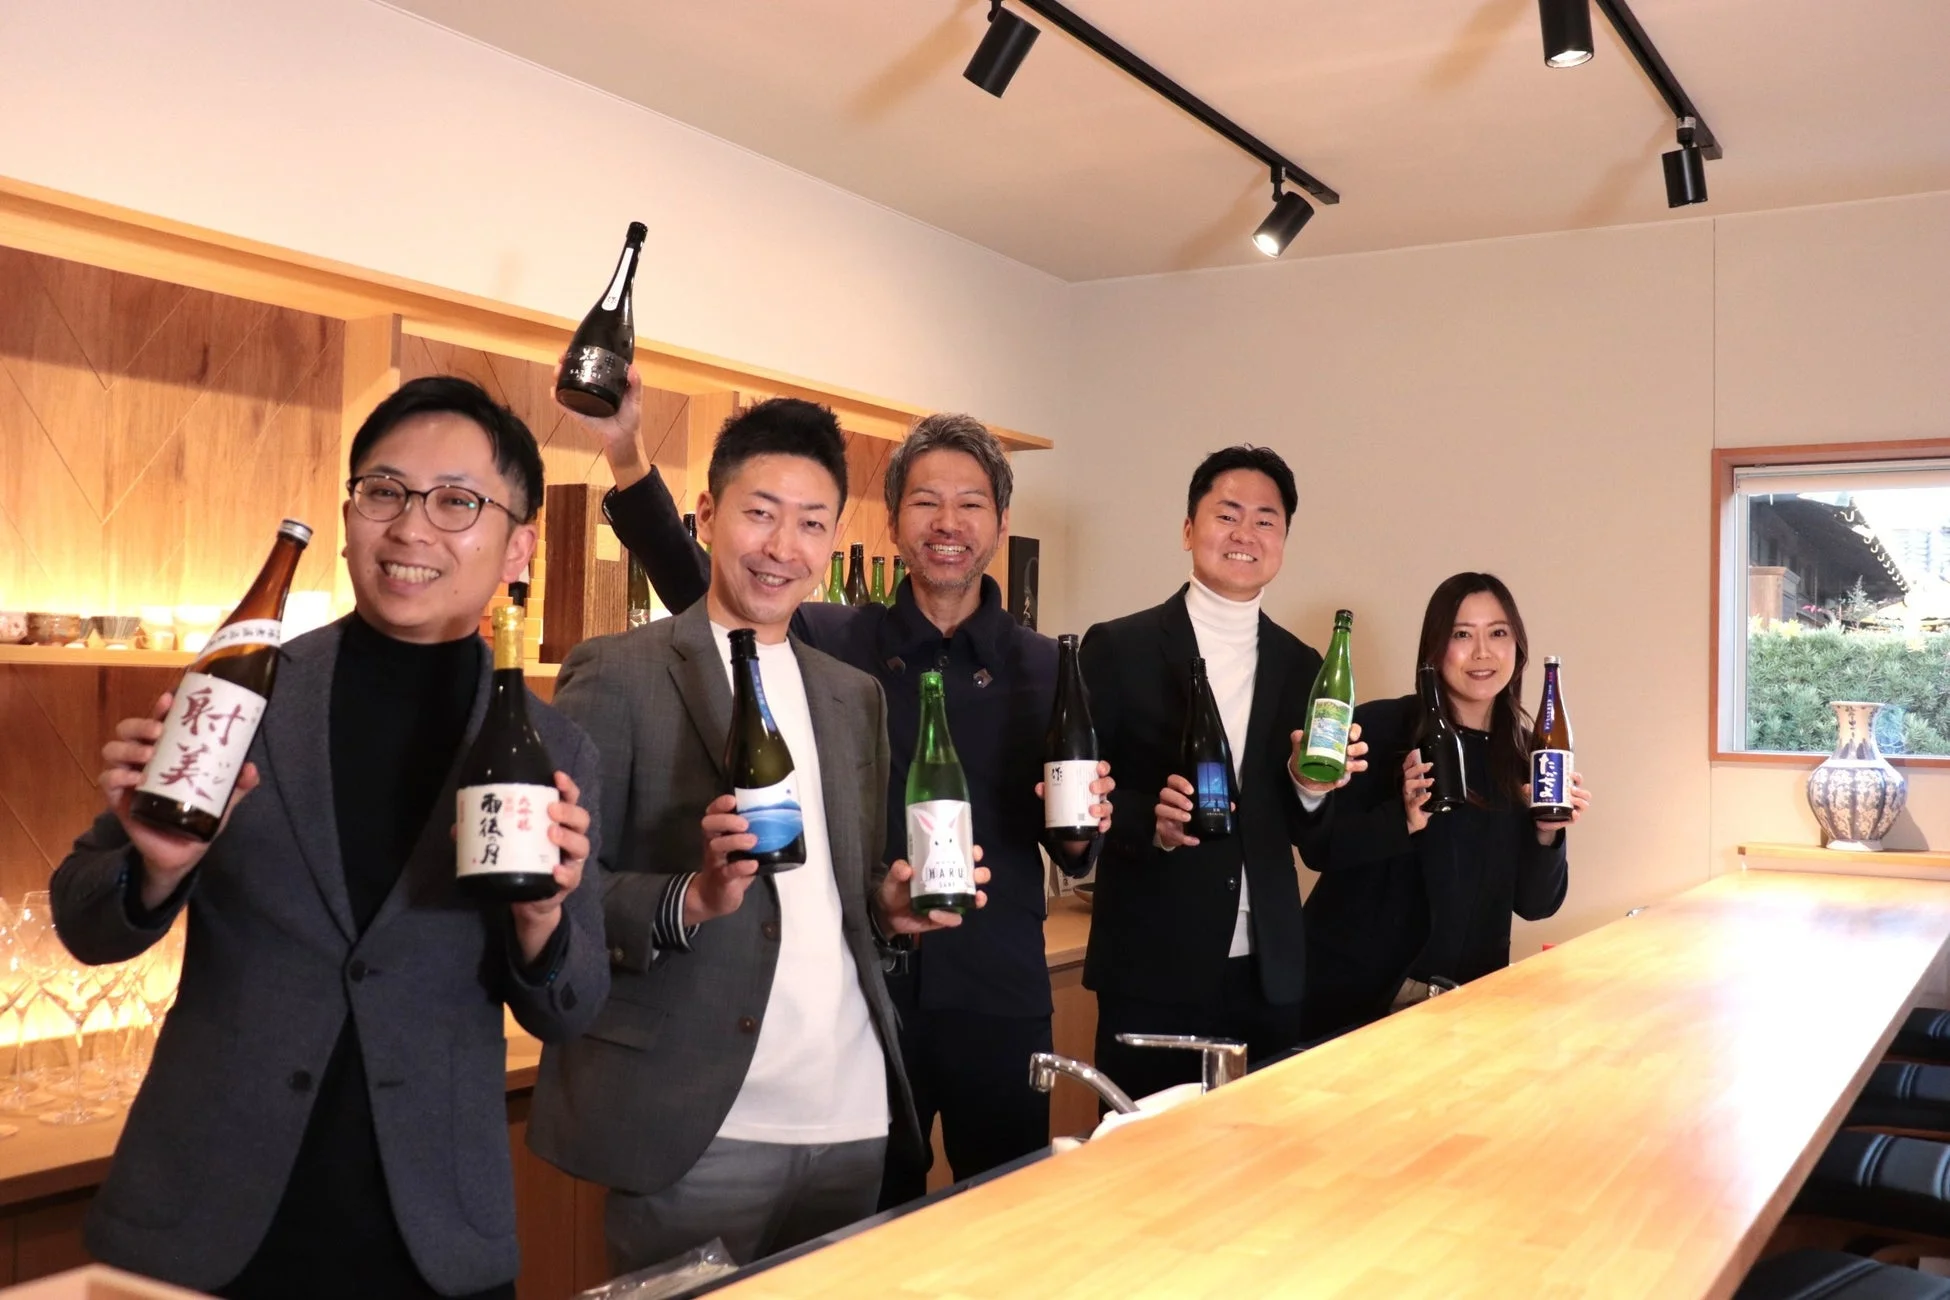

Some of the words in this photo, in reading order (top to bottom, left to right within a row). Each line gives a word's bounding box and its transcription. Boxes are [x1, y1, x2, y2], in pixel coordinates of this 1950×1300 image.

[159, 687, 245, 801] 射美
[480, 793, 503, 865] 雨後の月
[928, 867, 964, 879] HARU
